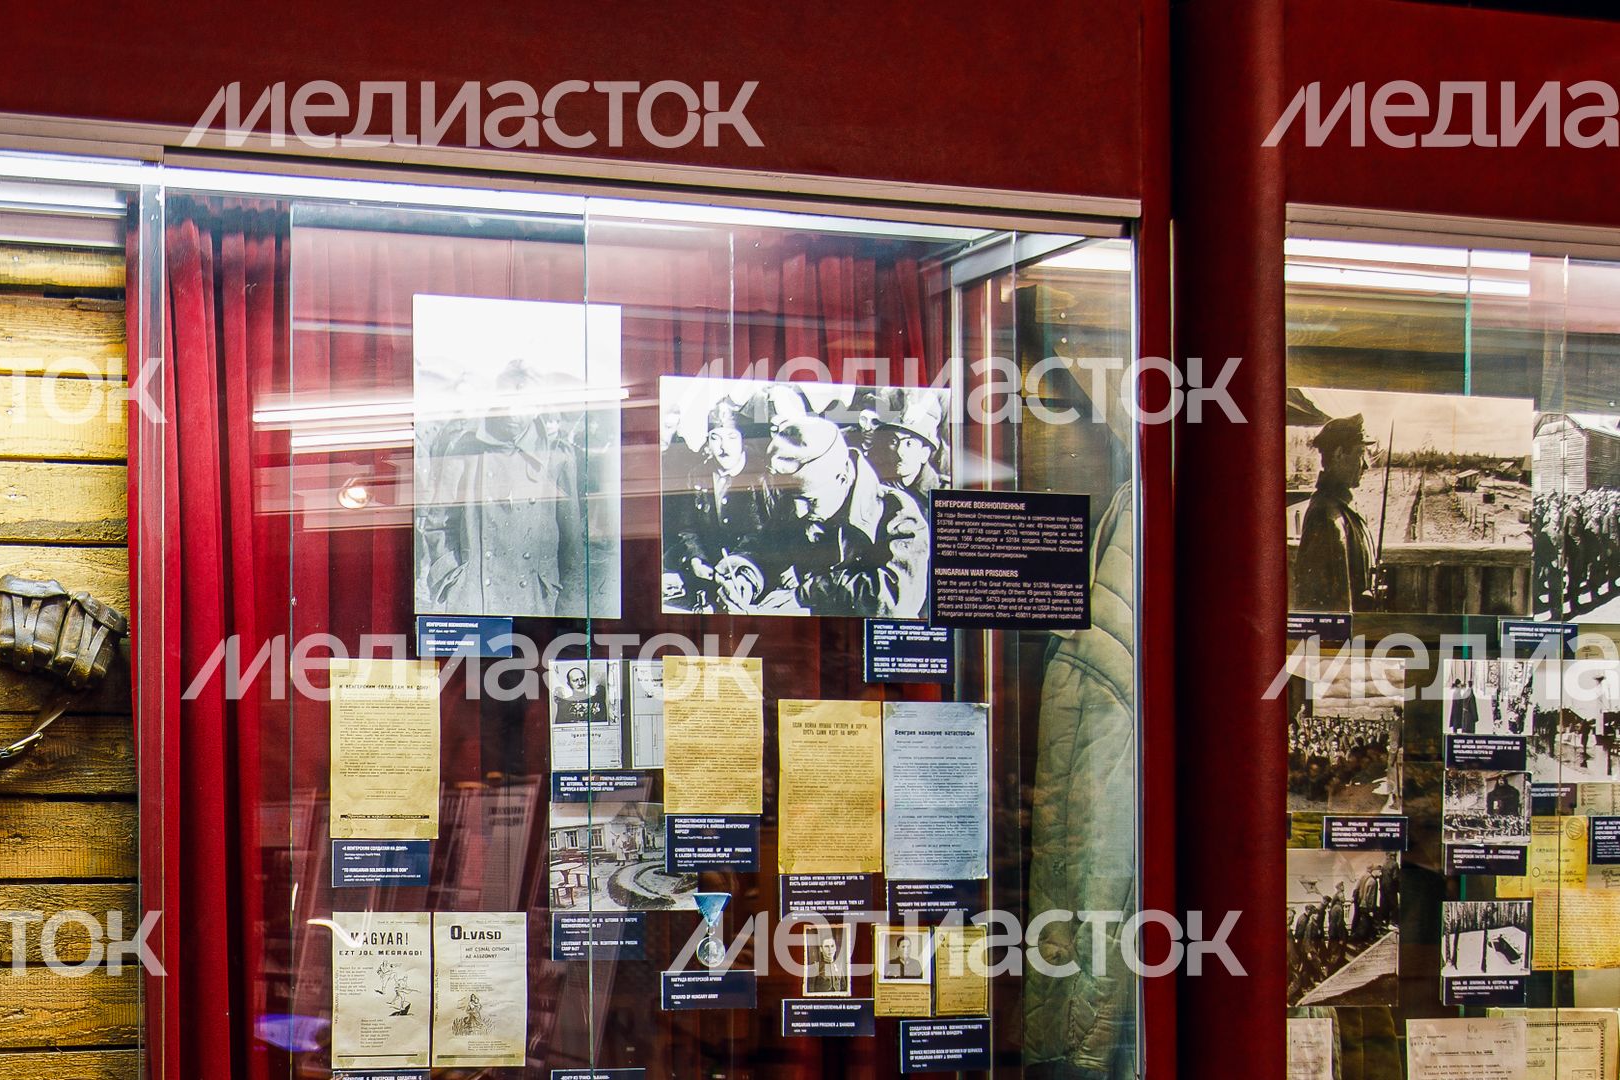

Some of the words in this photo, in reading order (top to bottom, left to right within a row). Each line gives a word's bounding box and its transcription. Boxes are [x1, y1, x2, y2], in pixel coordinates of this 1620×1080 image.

[935, 568, 969, 577] HUNGARIAN
[970, 569, 984, 577] WAR
[985, 569, 1018, 578] PRISONERS
